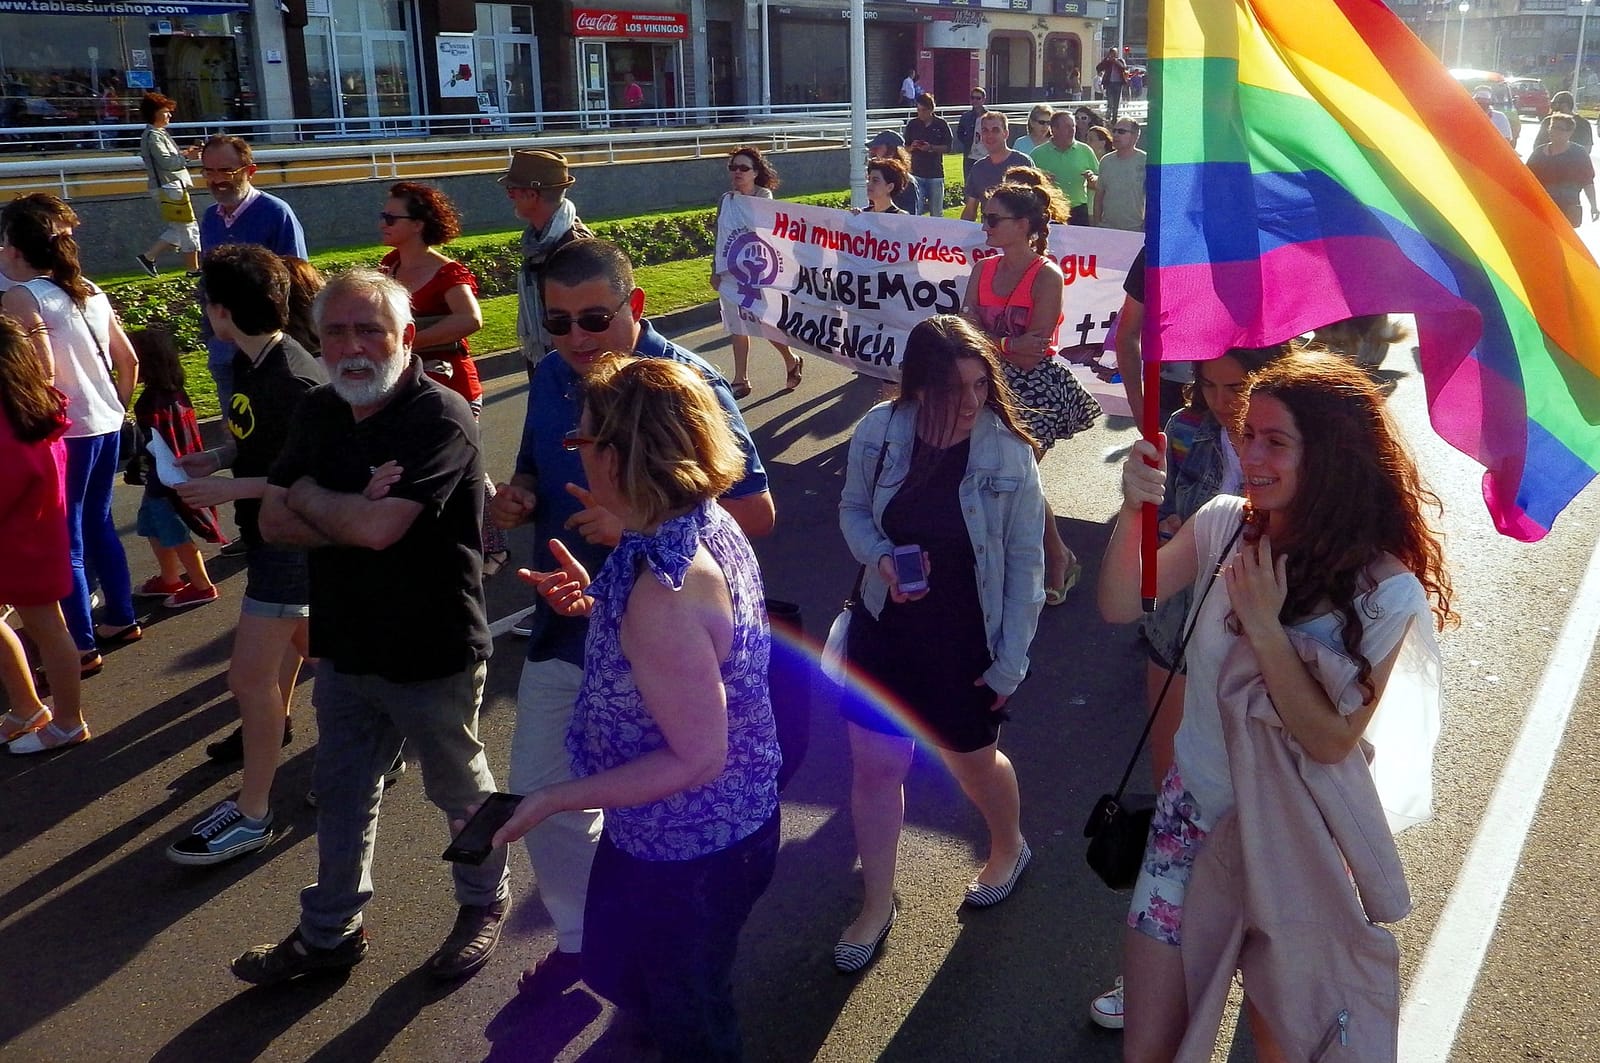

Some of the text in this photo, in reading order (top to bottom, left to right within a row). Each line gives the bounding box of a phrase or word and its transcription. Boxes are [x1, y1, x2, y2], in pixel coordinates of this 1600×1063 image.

[625, 23, 684, 33] LOS VIKINGOS
[772, 211, 806, 243] Hai
[810, 222, 901, 263] munches
[907, 236, 967, 266] vides
